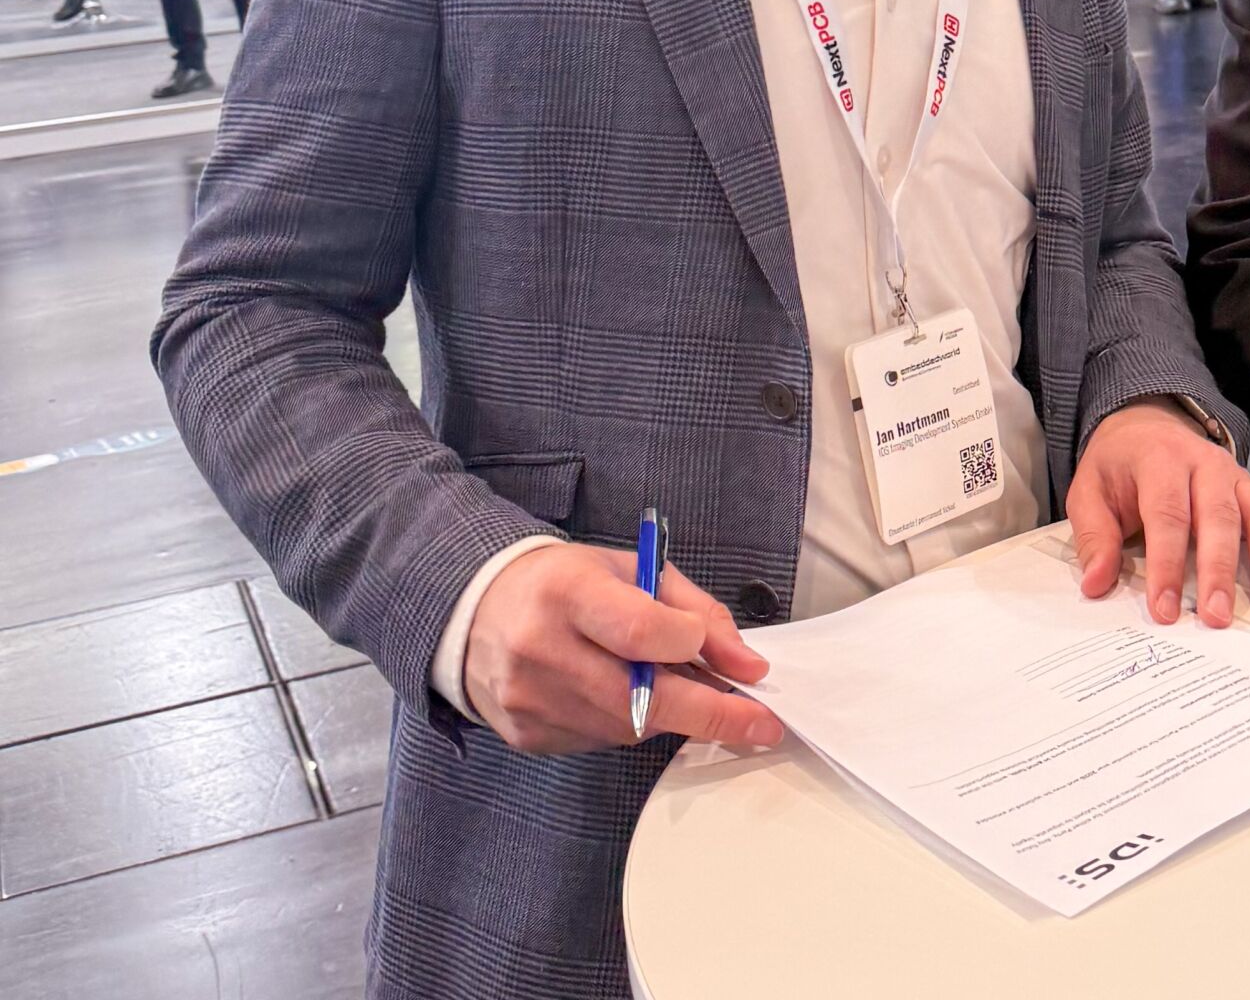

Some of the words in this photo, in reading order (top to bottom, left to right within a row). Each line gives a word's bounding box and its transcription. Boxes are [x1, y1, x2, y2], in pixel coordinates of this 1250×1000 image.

[807, 1, 848, 89] NextPCB
[929, 34, 957, 118] NextPCB
[876, 428, 895, 447] Jan
[896, 407, 950, 438] Hartmann
